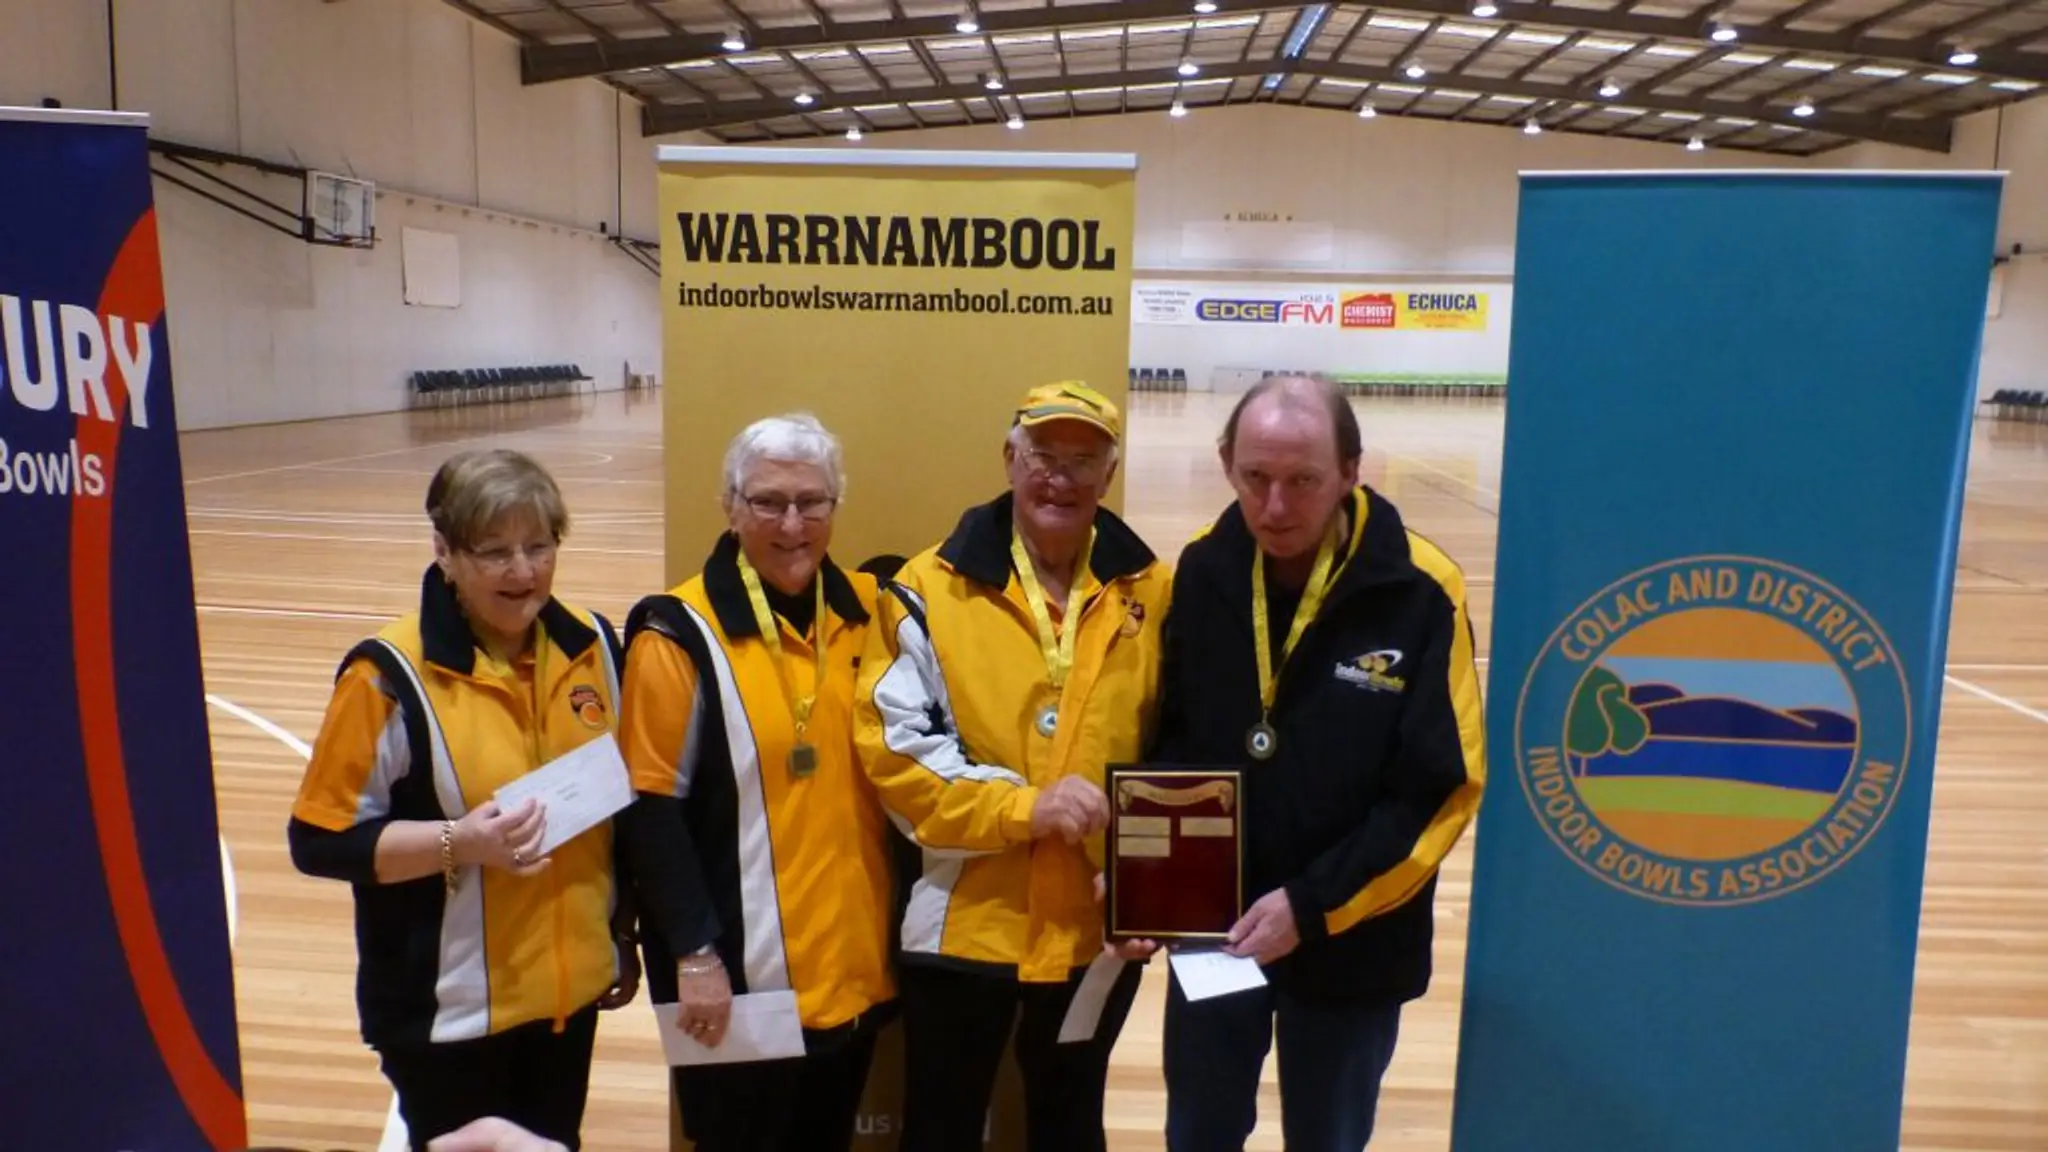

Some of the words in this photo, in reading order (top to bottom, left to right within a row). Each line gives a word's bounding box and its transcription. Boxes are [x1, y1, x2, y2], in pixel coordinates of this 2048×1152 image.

[677, 212, 1115, 271] WARRNAMBOOL
[679, 282, 1113, 316] indoorbowlswarrnambool.com.au
[1202, 302, 1278, 319] EDGE
[1280, 304, 1333, 324] FM
[1408, 294, 1476, 310] ECHUCA
[0, 438, 105, 496] Bowls
[1561, 581, 1661, 661] COLAC
[1668, 568, 1738, 605] AND
[1747, 571, 1886, 671] DISTRICT
[1527, 746, 1601, 856] INDOOR
[1597, 842, 1709, 898] BOWLS
[1718, 761, 1895, 898] ASSOCIATION
